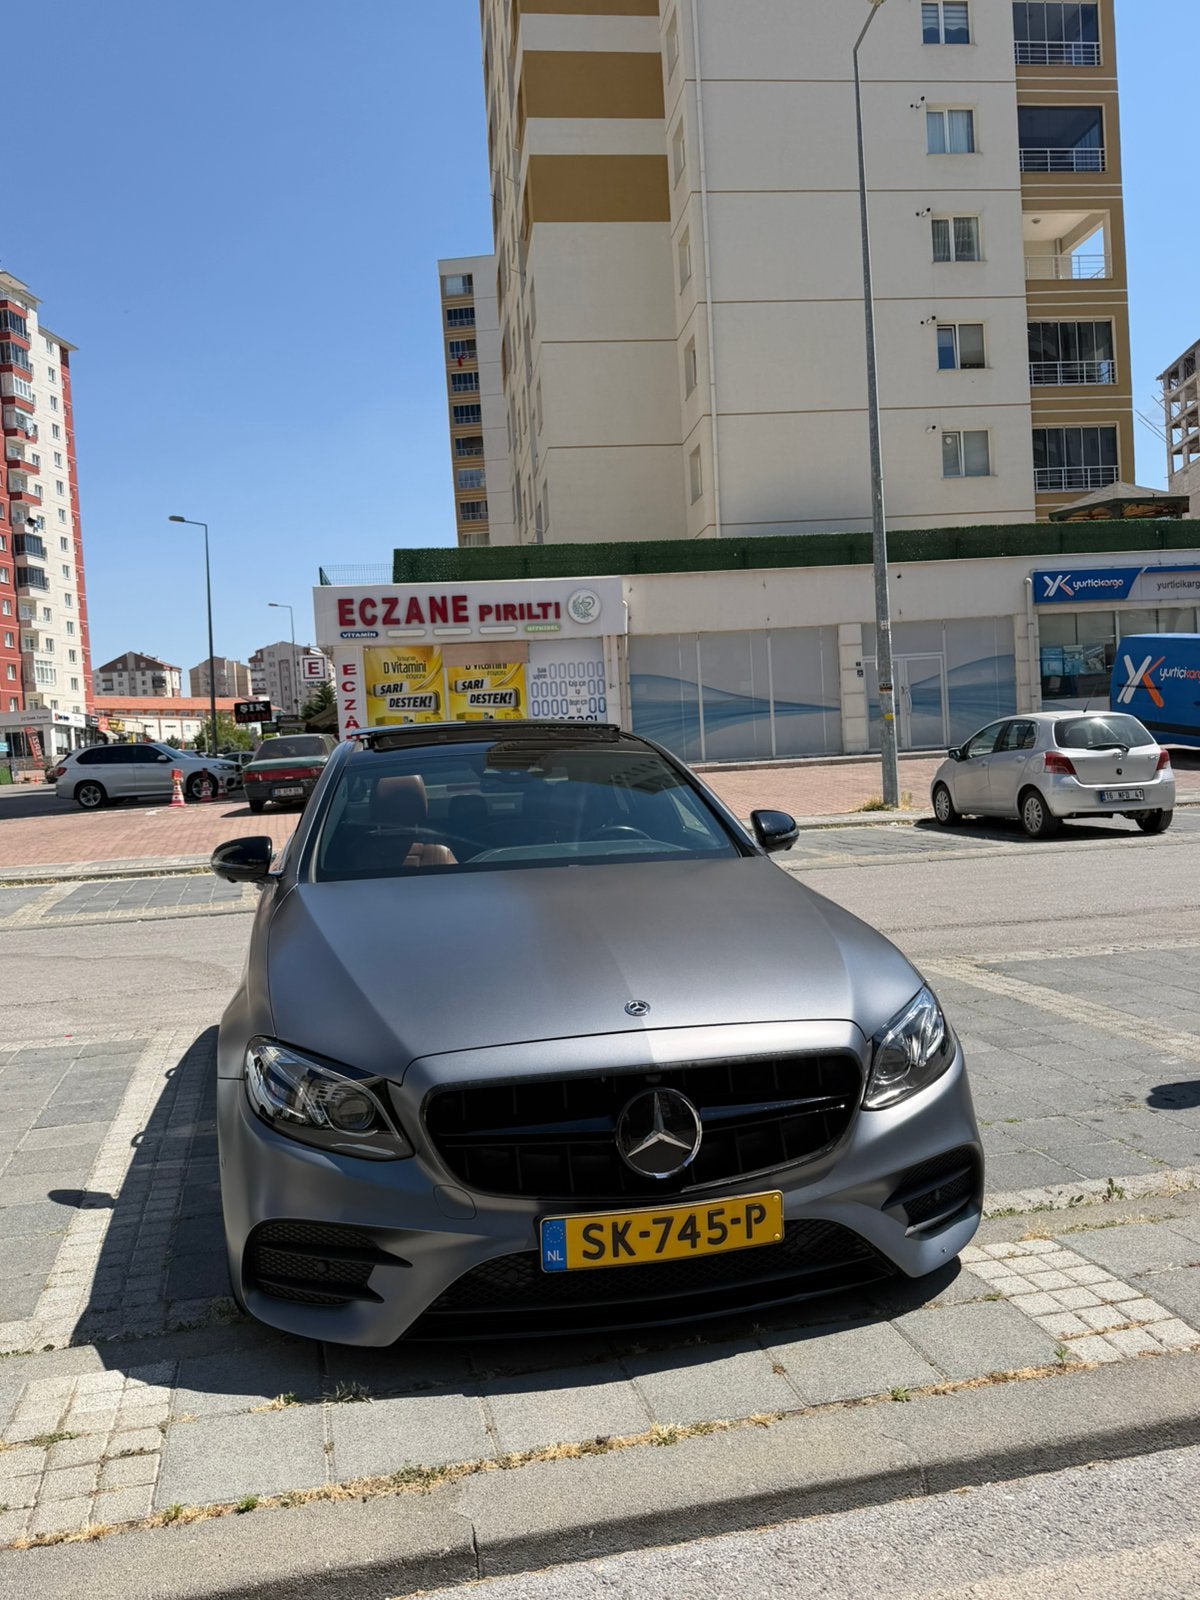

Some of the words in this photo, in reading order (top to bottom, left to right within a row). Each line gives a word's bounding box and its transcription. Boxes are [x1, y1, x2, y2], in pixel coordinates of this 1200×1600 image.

[337, 595, 469, 627] ECZANE
[478, 602, 561, 622] PIRILTI
[308, 661, 320, 675] E
[383, 662, 390, 674] D
[391, 660, 427, 674] Vitamini
[380, 683, 404, 695] SARI
[462, 679, 484, 691] SARI
[389, 696, 433, 708] DESTEK!
[470, 692, 513, 704] DESTEK!
[582, 1203, 766, 1260] SK-745-P
[547, 1251, 564, 1262] NL
